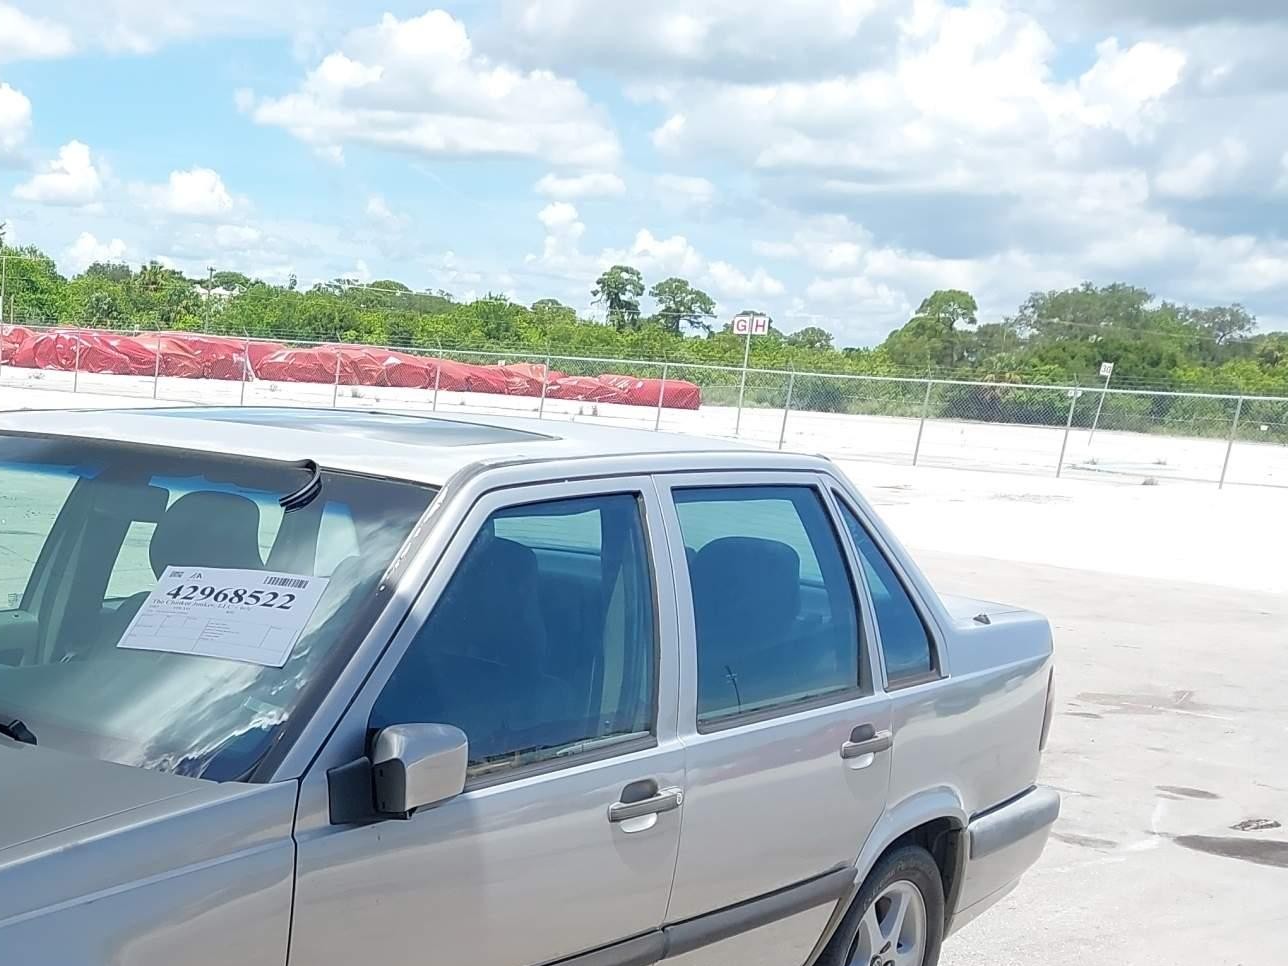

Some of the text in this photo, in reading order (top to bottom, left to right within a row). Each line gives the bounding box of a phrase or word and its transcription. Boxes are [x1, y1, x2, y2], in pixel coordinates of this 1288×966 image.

[736, 319, 766, 333] G H
[166, 584, 295, 610] 42968522
